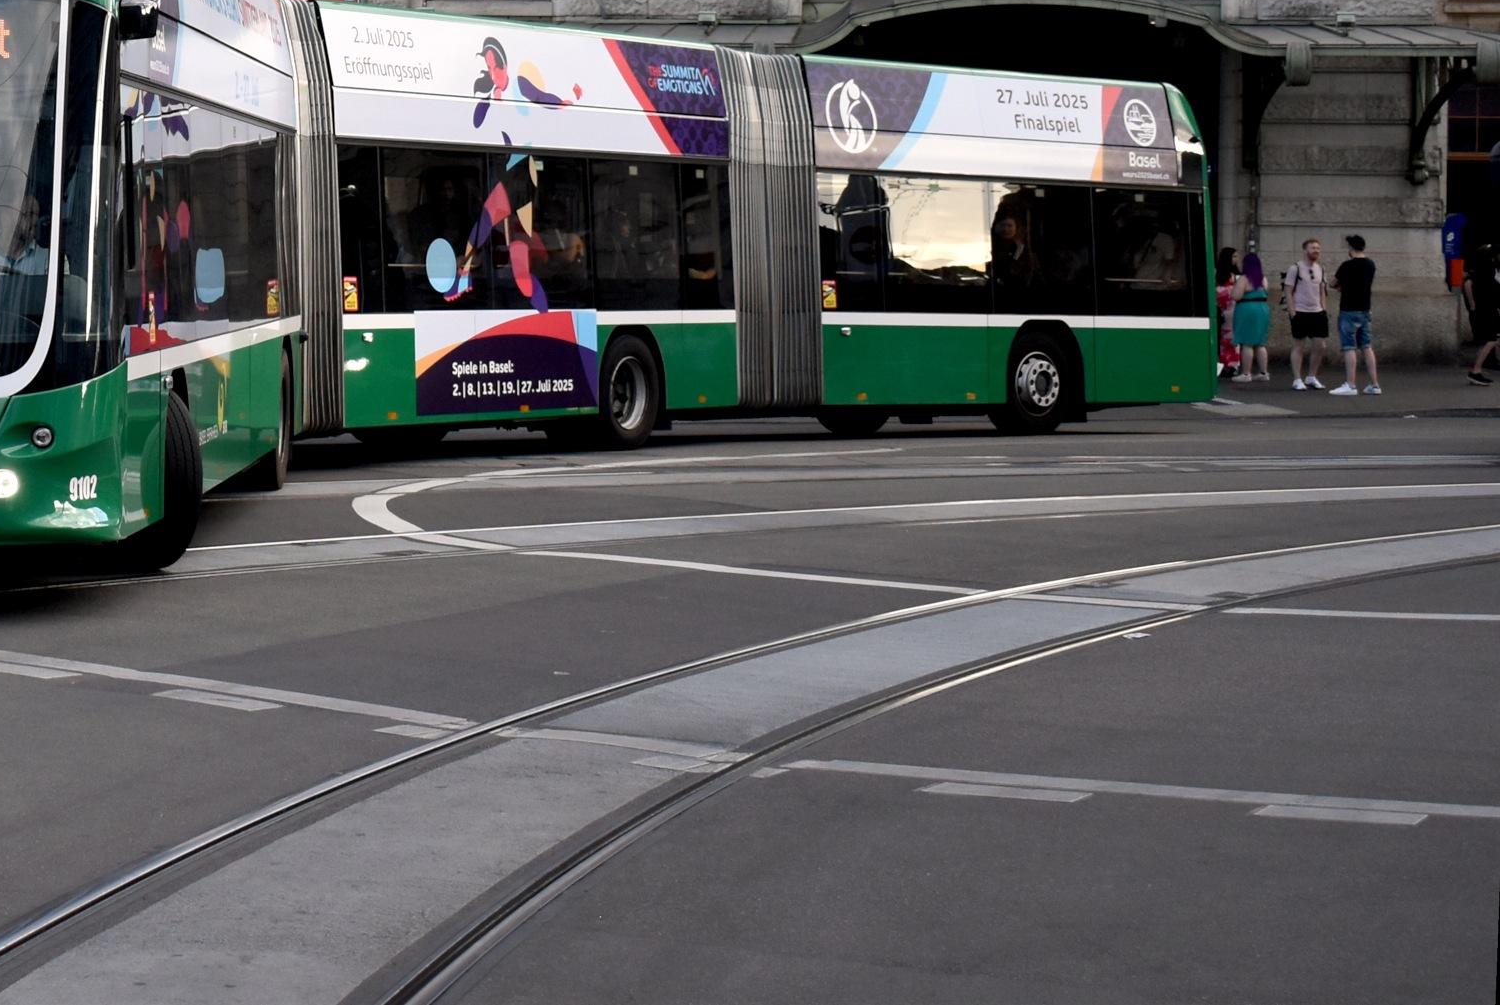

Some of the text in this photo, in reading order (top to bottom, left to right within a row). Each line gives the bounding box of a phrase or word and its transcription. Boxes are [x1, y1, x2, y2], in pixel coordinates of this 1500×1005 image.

[351, 26, 414, 48] 2. Juli 2025
[344, 56, 433, 83] Eröffnungsspiel
[657, 78, 703, 95] EMOTIONS
[996, 89, 1088, 109] 27. Juli 2025
[1014, 114, 1081, 135] Finalspiel
[1129, 151, 1161, 168] Basel
[452, 360, 514, 378] Spiele in Basel:
[521, 380, 535, 393] 27.
[536, 379, 551, 393] Juli
[552, 378, 574, 392] 2025
[69, 474, 98, 501] 9102
